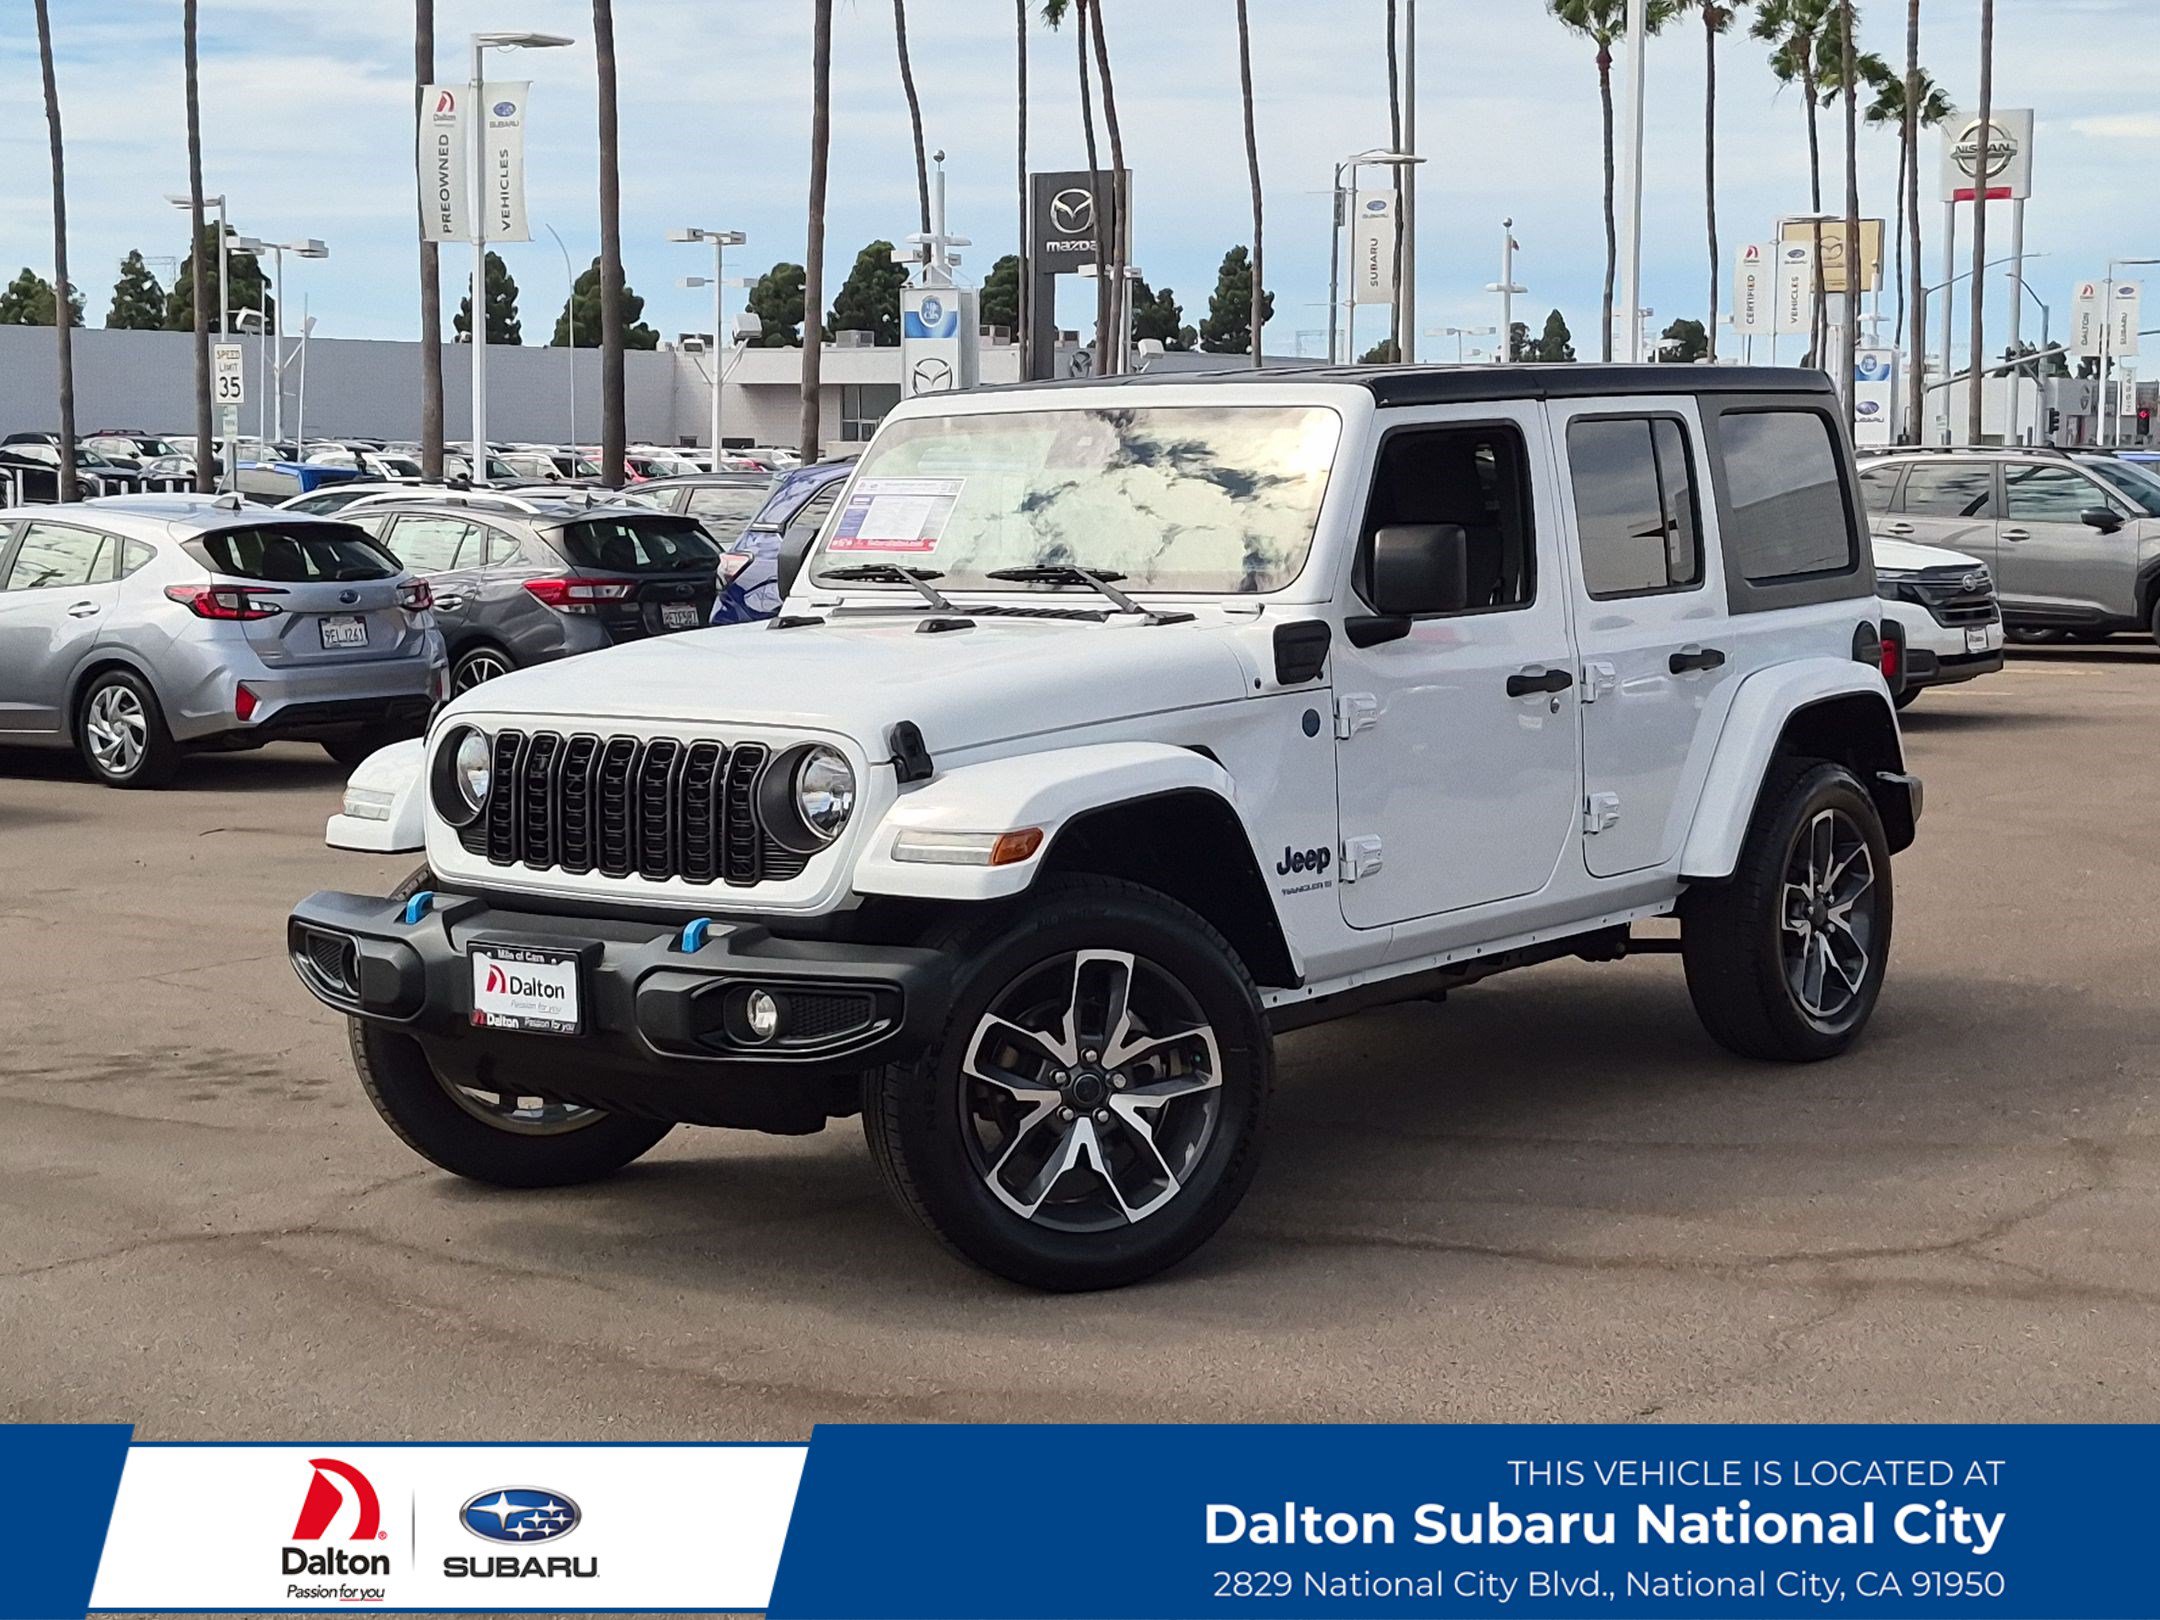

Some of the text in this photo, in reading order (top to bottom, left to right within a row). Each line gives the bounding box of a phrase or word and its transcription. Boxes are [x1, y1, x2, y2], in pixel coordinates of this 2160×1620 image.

[1956, 143, 2010, 154] NISAN
[438, 134, 453, 234] PREOWNED
[499, 149, 511, 231] VEHICLES
[1370, 238, 1379, 287] SUBARU
[1746, 275, 1755, 324] CERTIFIED
[1790, 276, 1799, 324] VEHICLES
[216, 350, 240, 360] SPEED
[219, 363, 239, 372] LIMIT
[219, 376, 241, 398] 35
[1276, 846, 1331, 876] Jeep
[497, 949, 545, 963] Mile of Cars
[510, 976, 565, 1000] Dalton
[486, 1012, 520, 1029] Dalton
[525, 1016, 575, 1033] Passion for you
